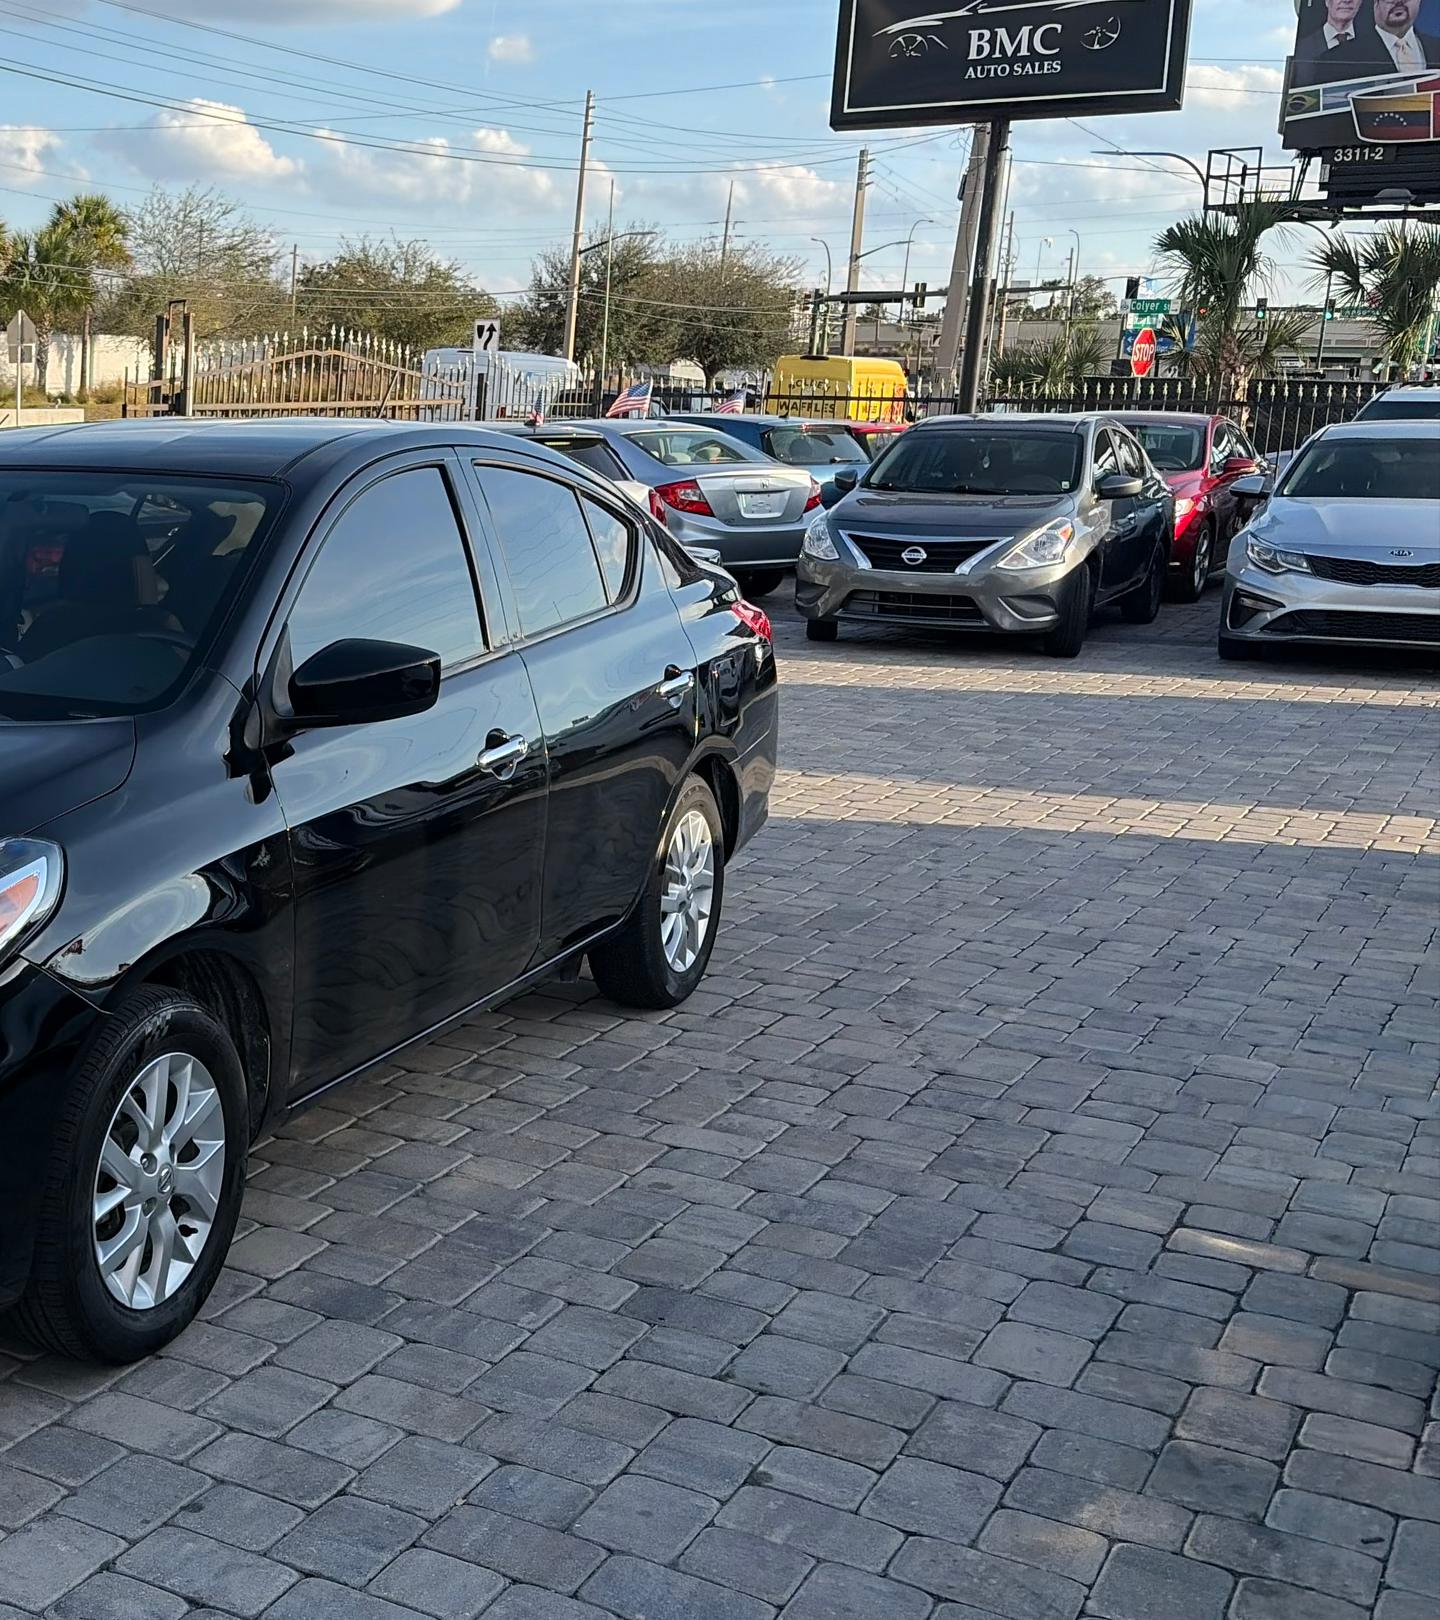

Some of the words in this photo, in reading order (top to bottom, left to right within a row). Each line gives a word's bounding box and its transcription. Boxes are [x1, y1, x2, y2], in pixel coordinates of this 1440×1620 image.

[967, 23, 1062, 60] BMC
[964, 63, 1010, 79] AUTO
[1013, 60, 1062, 76] SALES
[1333, 146, 1384, 162] 3311-2
[1131, 301, 1160, 312] Colyer
[1134, 343, 1155, 361] STOP
